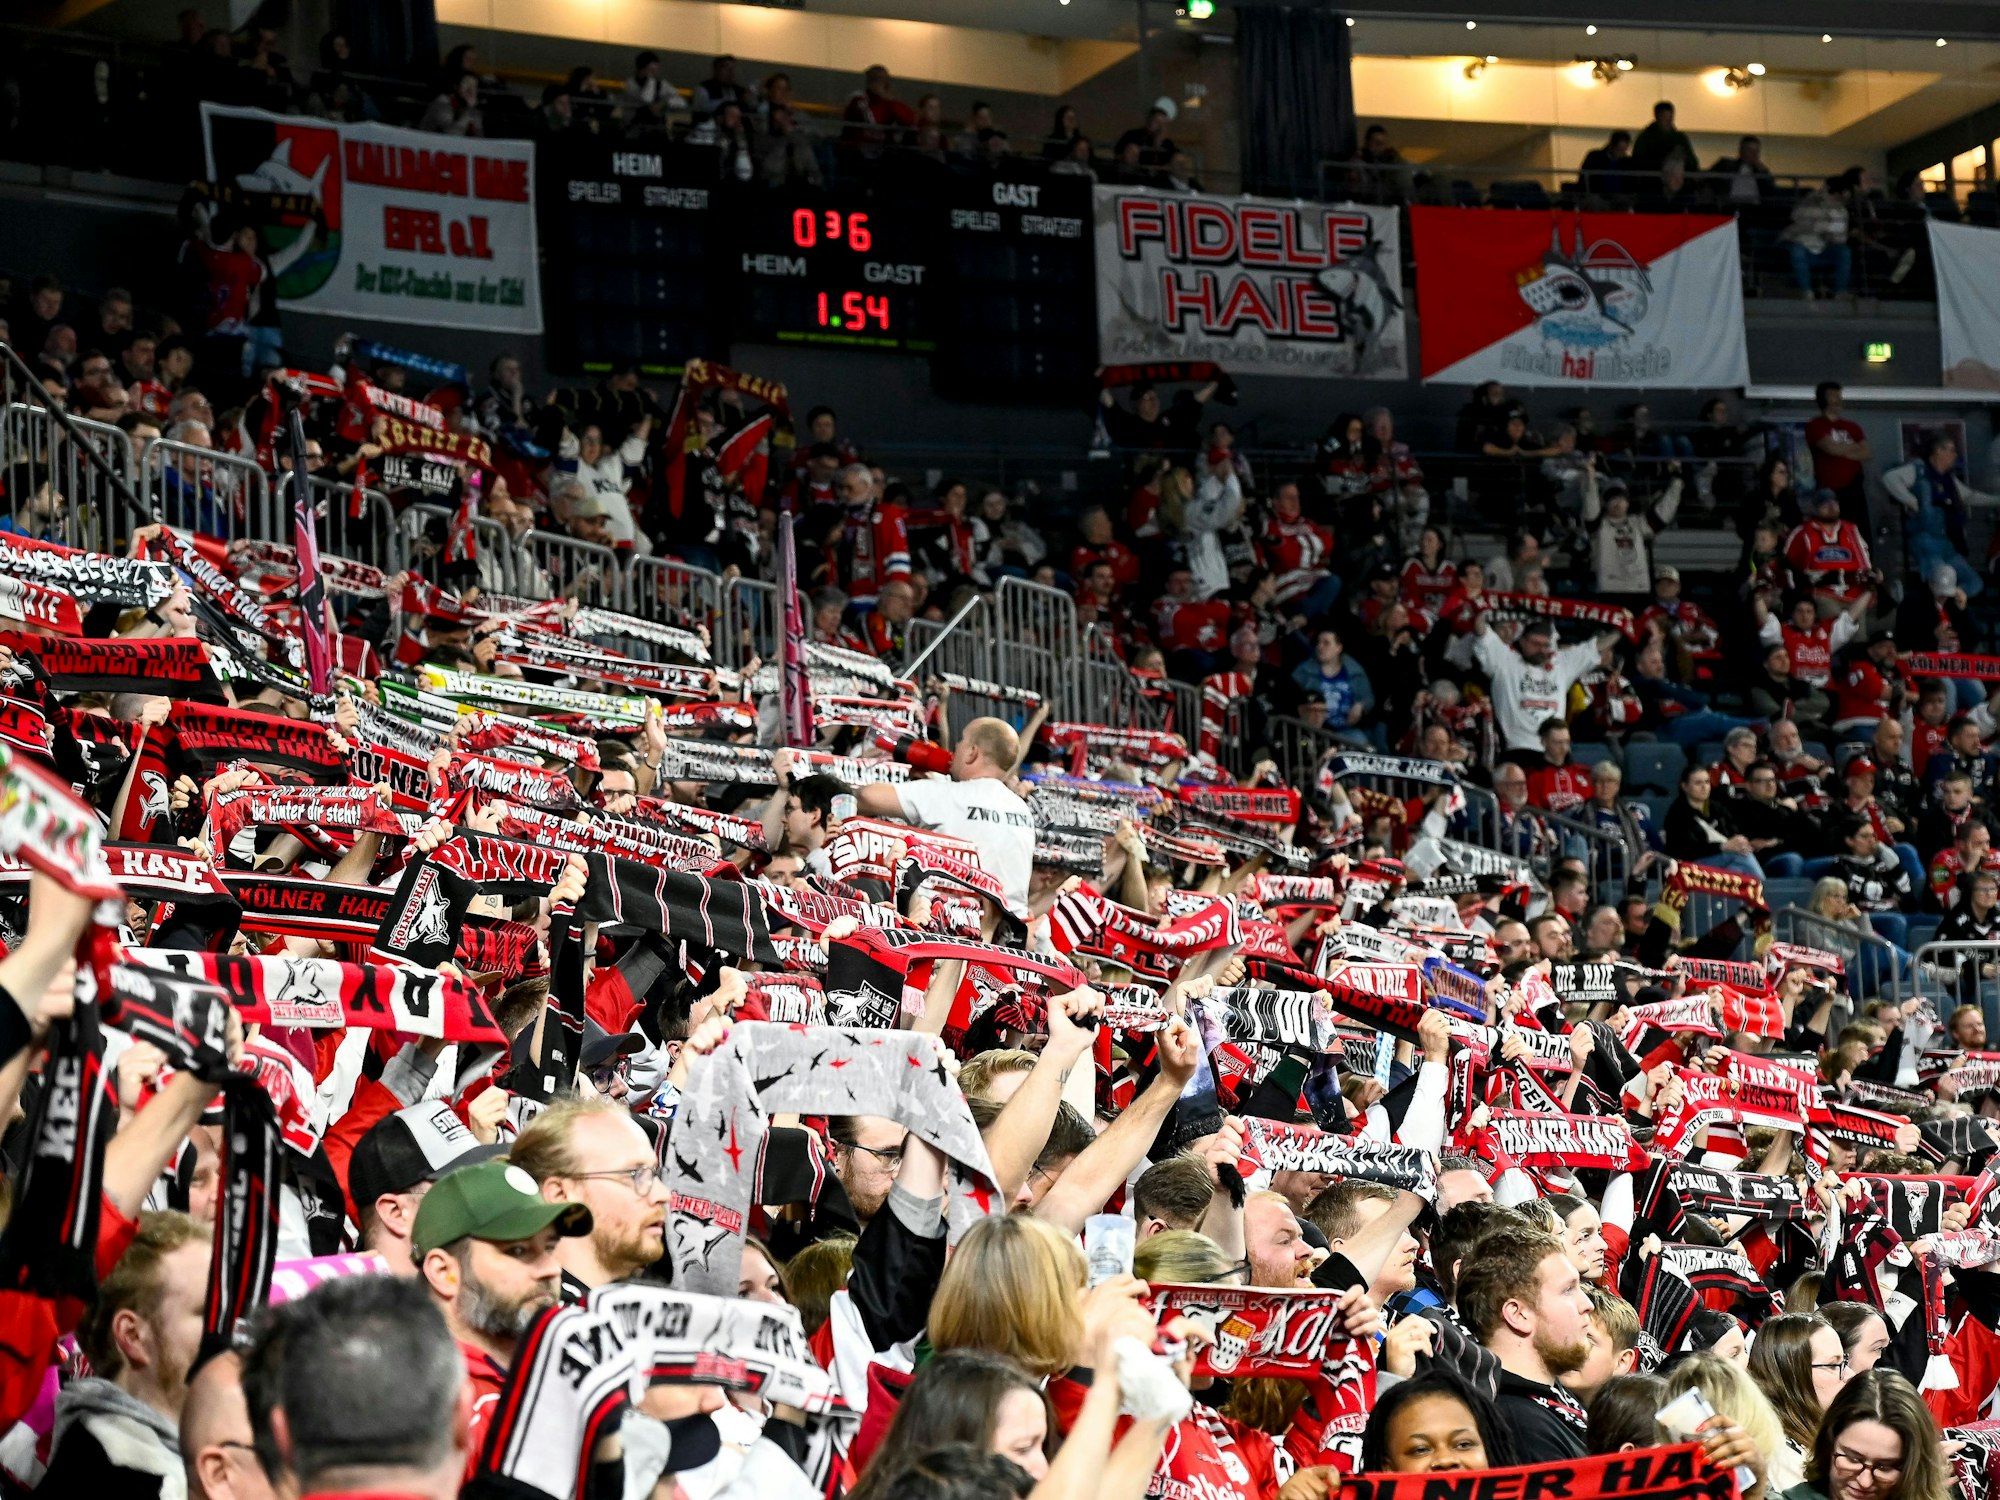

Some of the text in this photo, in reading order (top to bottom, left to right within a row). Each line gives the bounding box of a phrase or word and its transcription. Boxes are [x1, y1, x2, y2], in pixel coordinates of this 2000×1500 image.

[612, 151, 663, 178] HEIM
[567, 179, 711, 210] SPIELER STRAFZEIT
[992, 181, 1040, 207] GAST
[950, 209, 1083, 239] SPIELER STRAFZEIT
[1114, 196, 1371, 269] FIDELE
[741, 252, 927, 287] HEIM GAST
[1160, 268, 1346, 341] HAIE
[0, 540, 70, 579] ÖLNER
[41, 636, 201, 680] KÖLNER HAIE
[350, 742, 430, 803] ÖLNE
[268, 797, 305, 822] hinter
[307, 799, 324, 822] dir
[326, 803, 361, 826] steht!
[966, 806, 1000, 824] ZWO
[121, 850, 213, 894] HAIE
[238, 883, 391, 921] KÖLNER HAIE
[1249, 926, 1288, 957] Haie
[1375, 968, 1409, 998] HAIE
[1555, 964, 1616, 992] DIE HAIE
[36, 1056, 83, 1163] KEC
[1835, 1112, 1872, 1133] MEIN
[1490, 1118, 1629, 1158] KÖLNER HAIE
[1857, 1131, 1882, 1146] SEIT
[1883, 1138, 1896, 1150] 19
